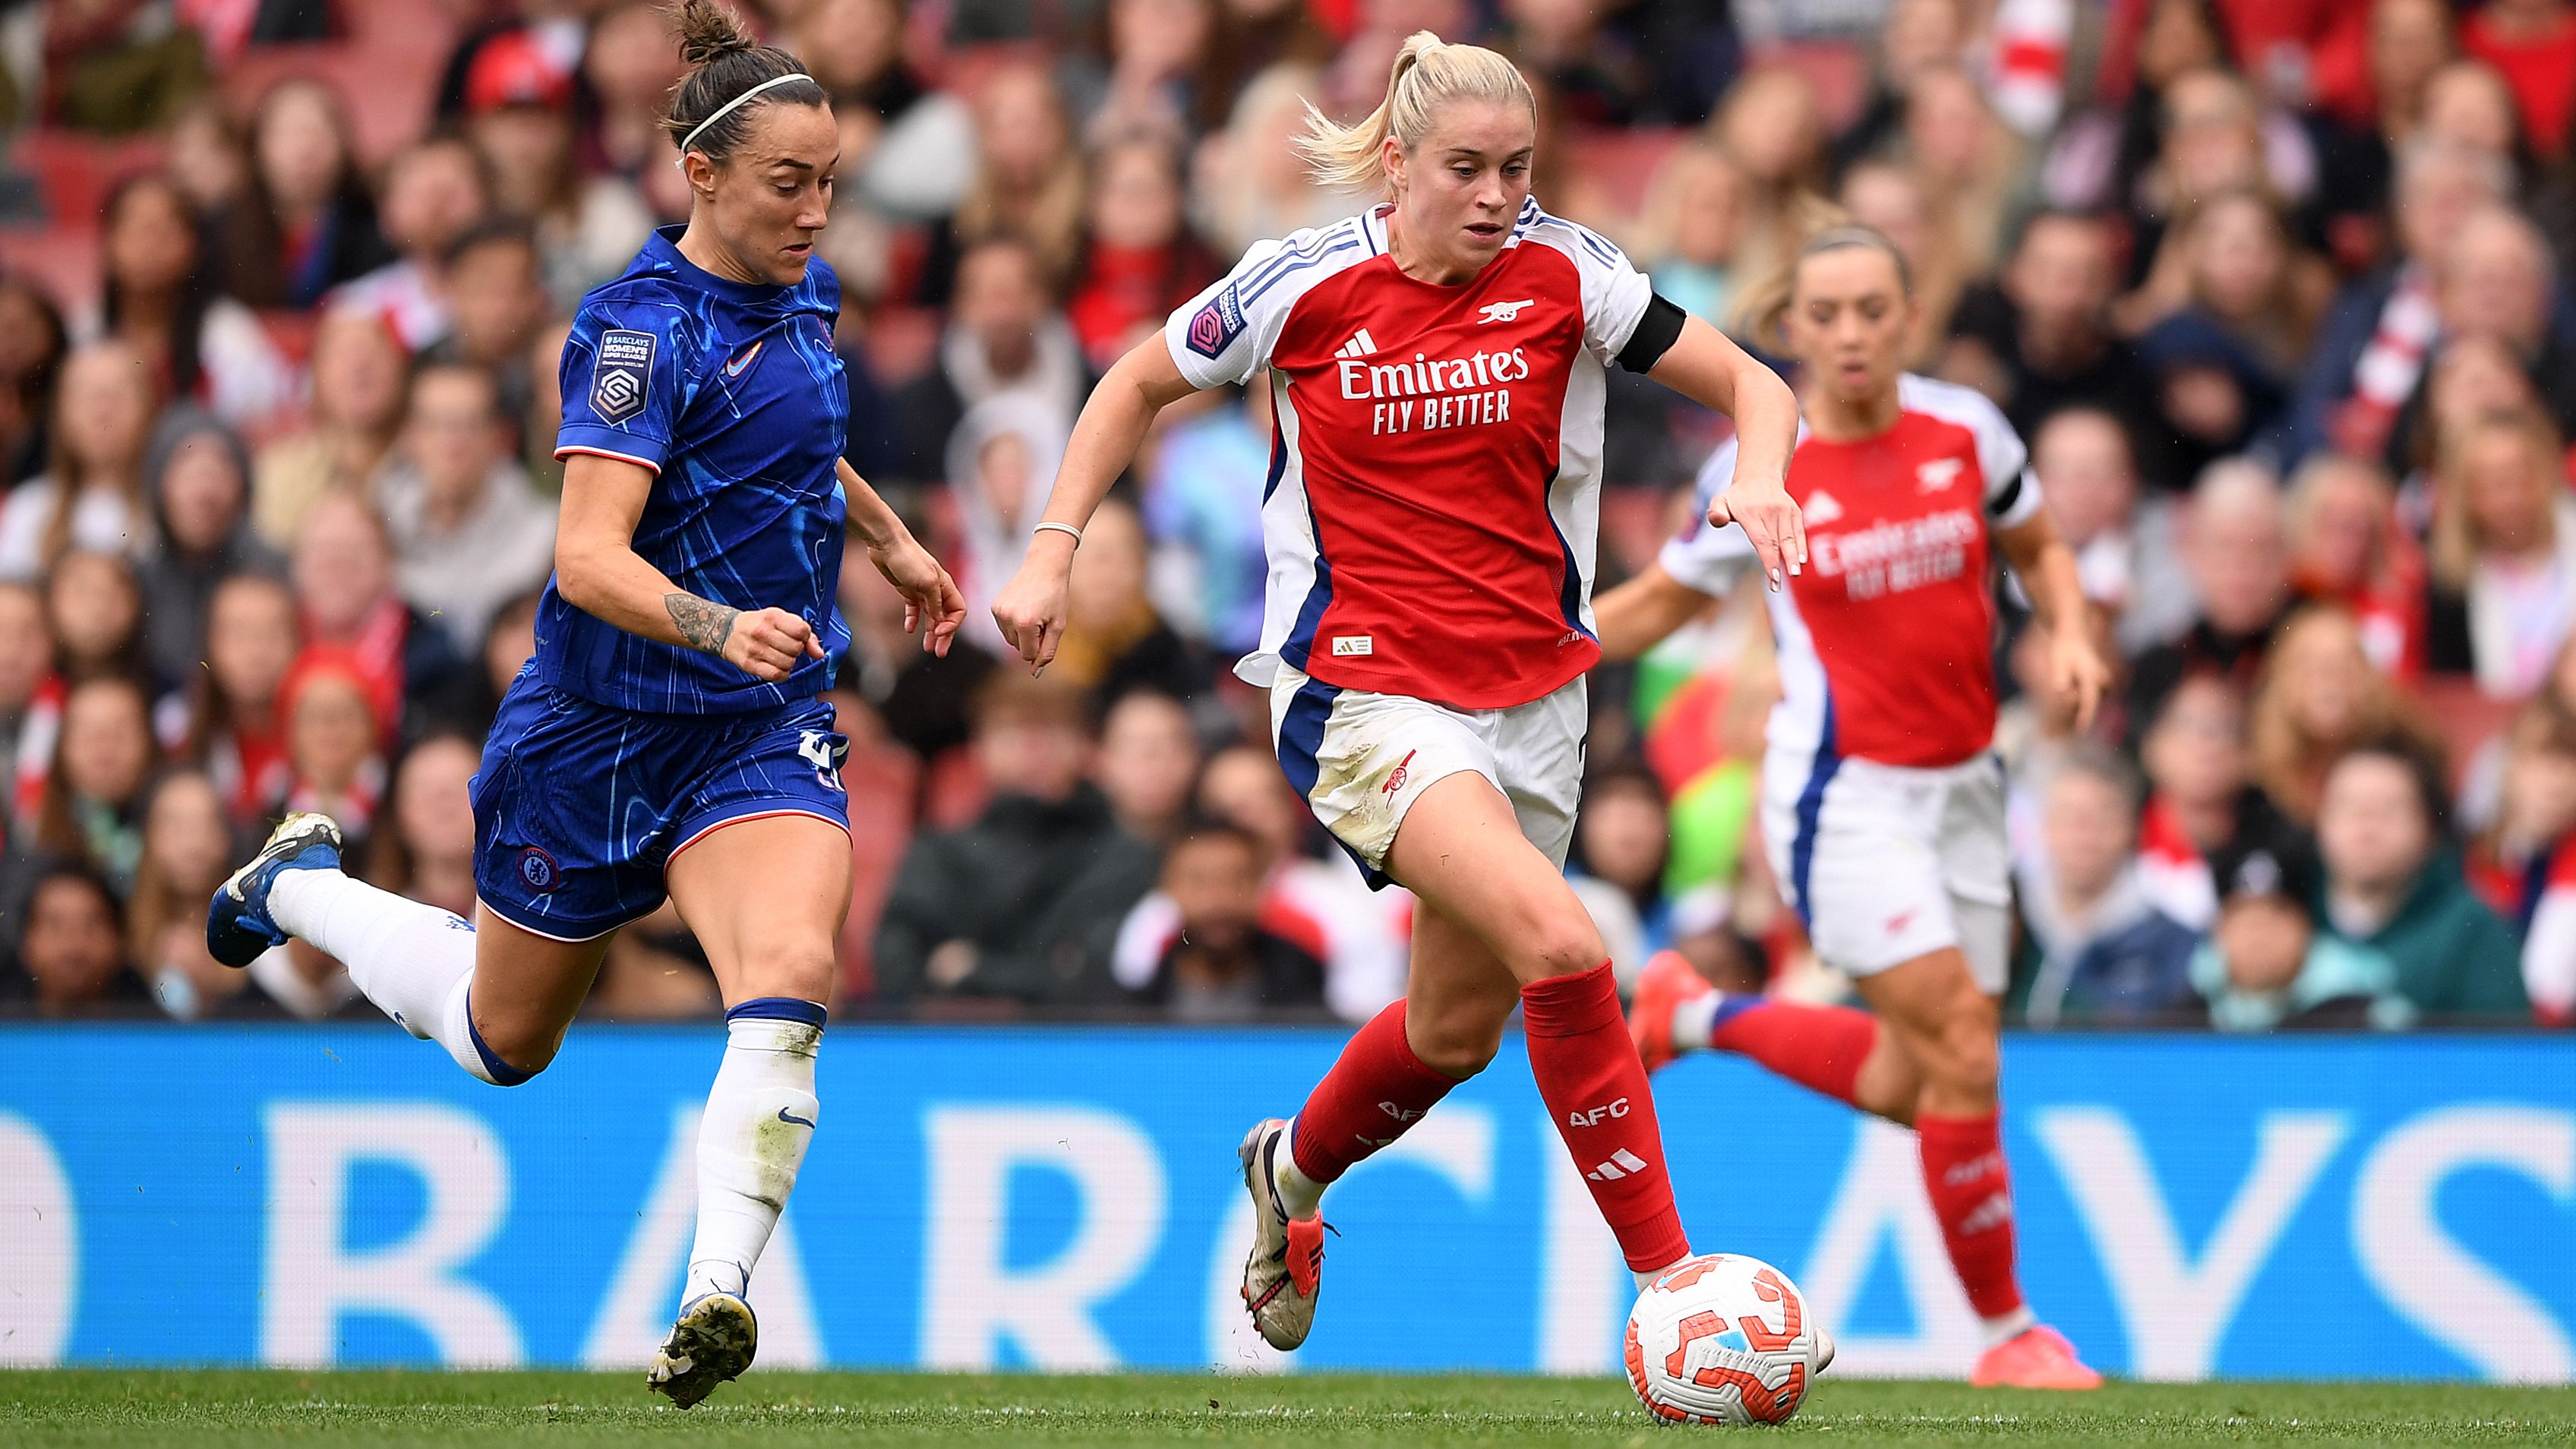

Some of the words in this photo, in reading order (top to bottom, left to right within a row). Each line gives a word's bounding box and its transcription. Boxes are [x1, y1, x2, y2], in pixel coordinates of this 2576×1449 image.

[604, 344, 648, 355] WOMEN'S
[613, 336, 649, 347] BARCLAYS
[621, 352, 647, 361] LEAGUE
[1337, 347, 1529, 399] Emirates
[1372, 400, 1415, 436] FLY
[1423, 389, 1510, 431] BETTER
[1810, 507, 1978, 578] Emirates
[1378, 1101, 1428, 1122] AF
[1570, 1097, 1630, 1128] AFC
[260, 1100, 2576, 1376] BARCLAYS
